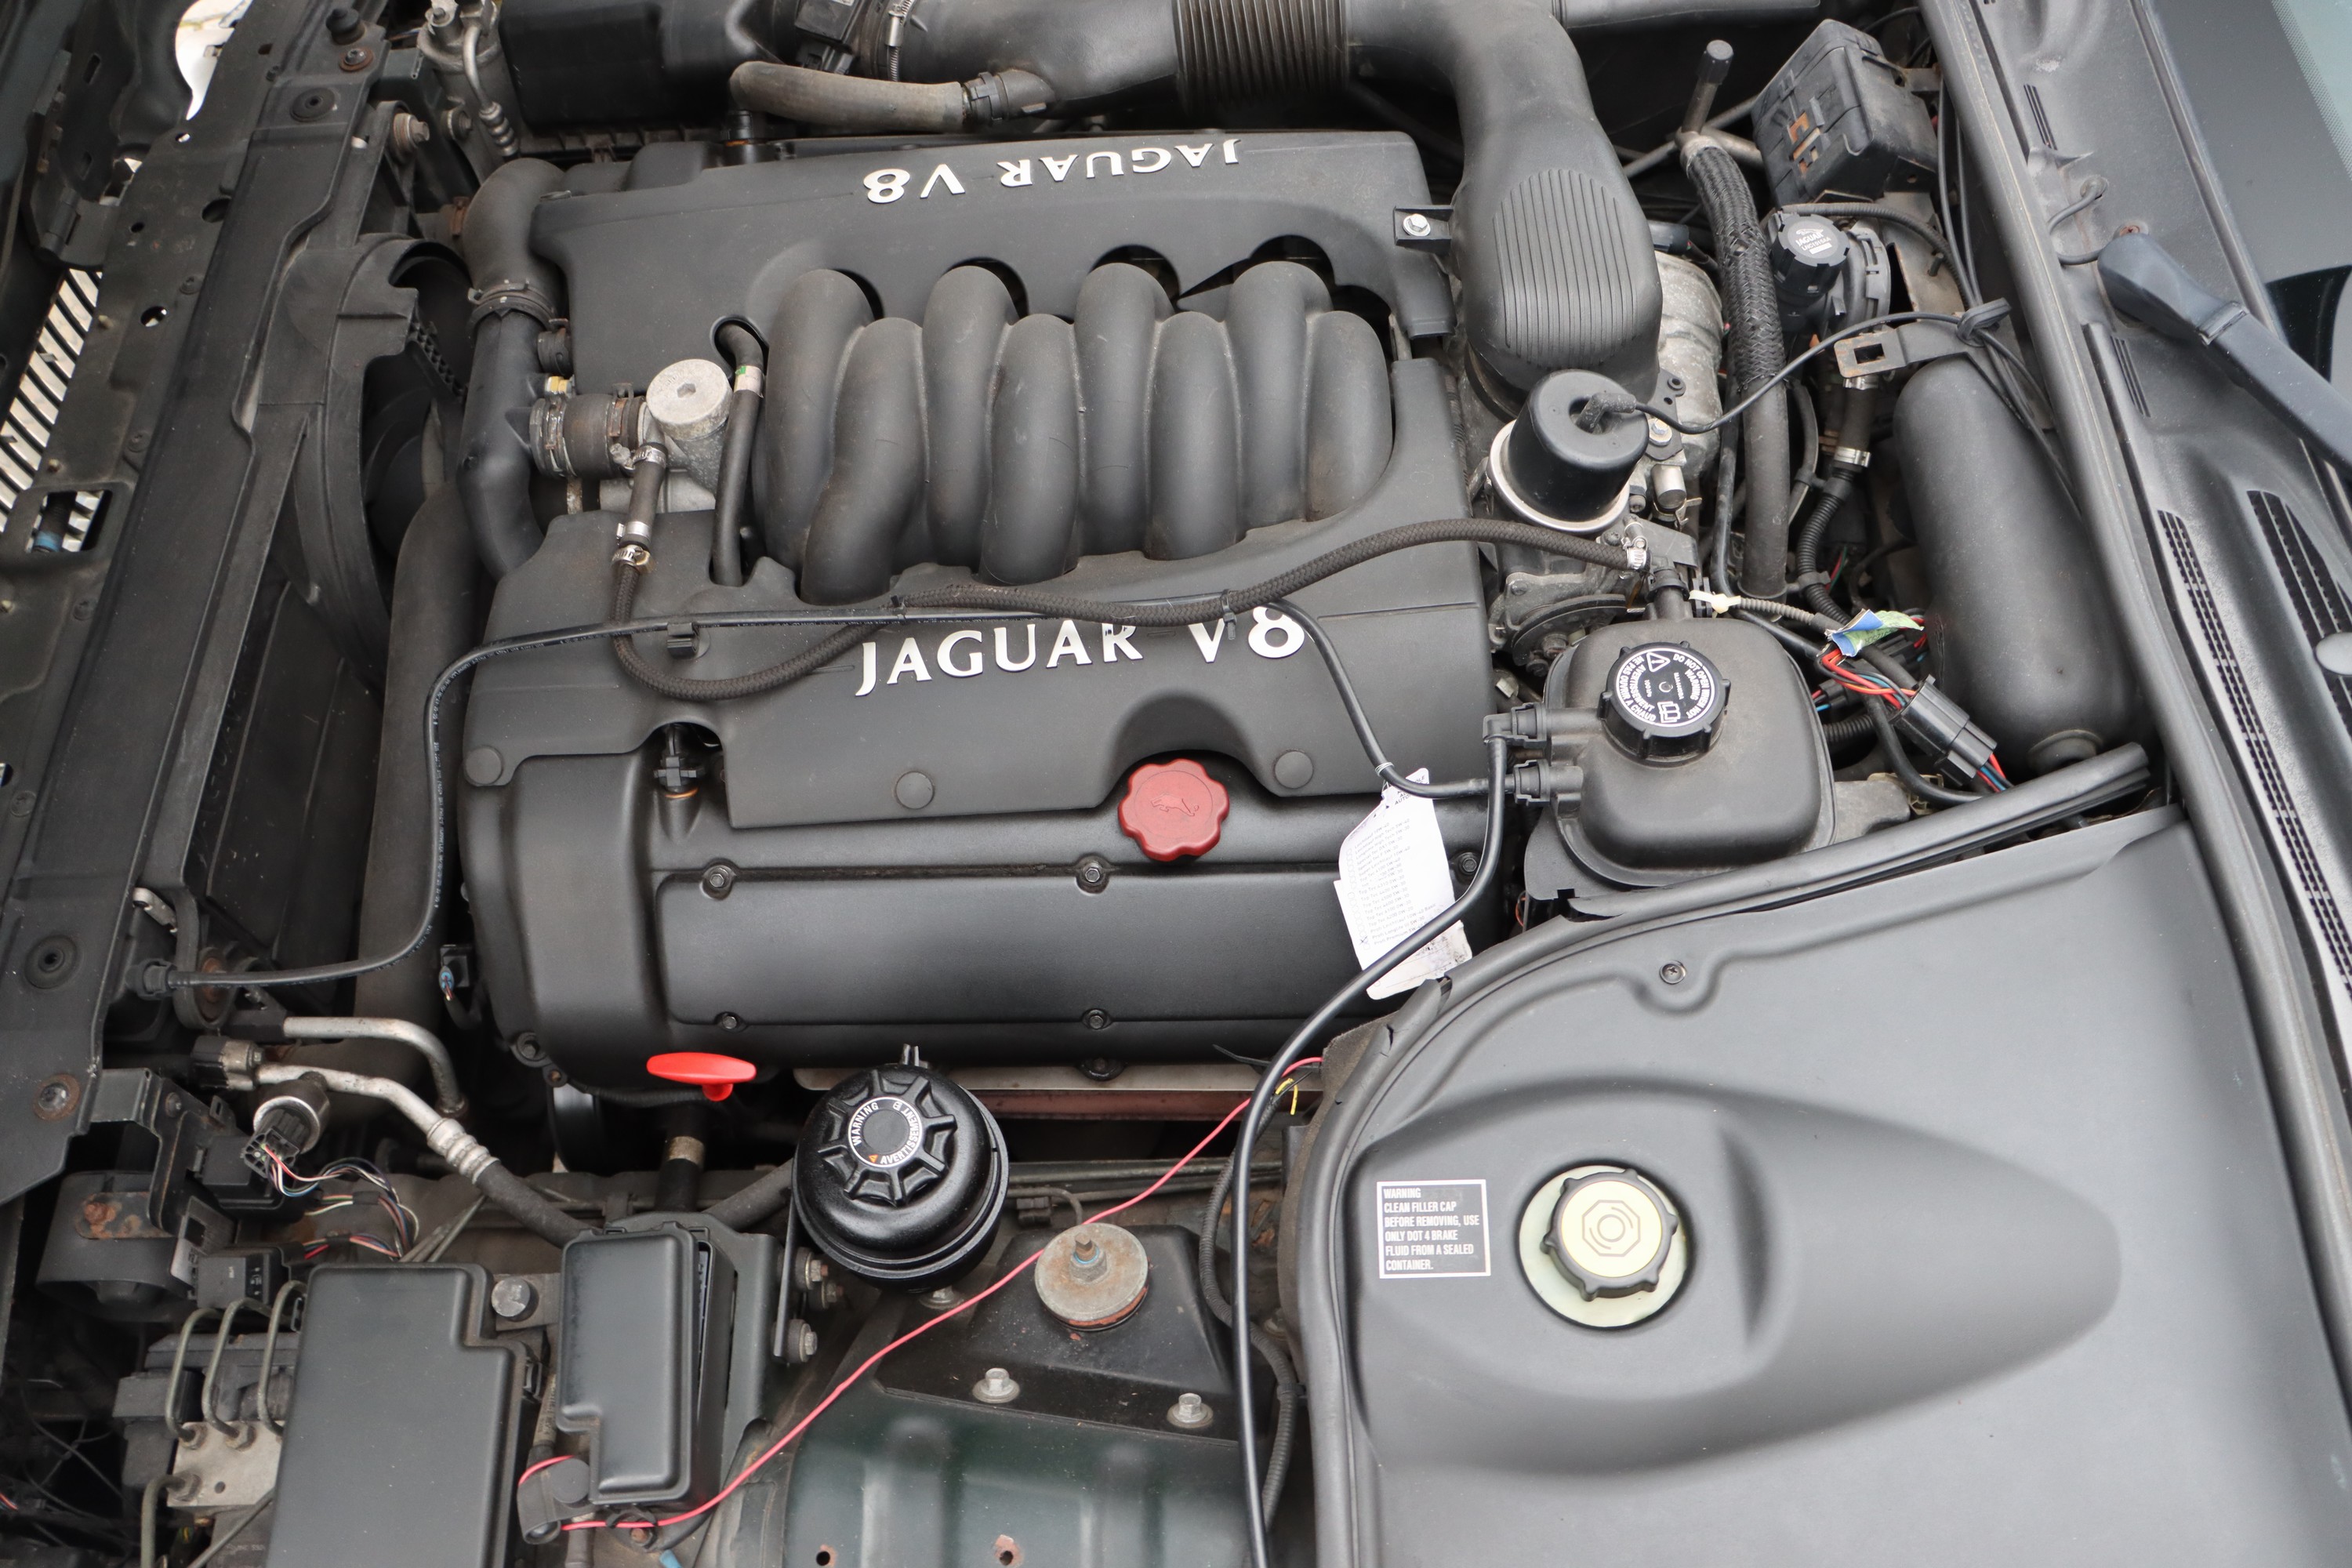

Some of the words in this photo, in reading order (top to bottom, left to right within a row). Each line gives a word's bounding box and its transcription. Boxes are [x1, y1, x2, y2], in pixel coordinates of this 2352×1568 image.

[996, 138, 1242, 188] JAGUAR
[862, 163, 967, 205] V8
[1795, 232, 1824, 247] JAGUAR
[855, 619, 1143, 698] JAGUAR
[1188, 606, 1305, 663] V8
[1633, 655, 1645, 664] NE
[1673, 653, 1685, 663] DO
[1622, 662, 1636, 675] PAS
[1685, 659, 1700, 671] NOT
[1685, 669, 1700, 701] WARNING
[1696, 669, 1710, 688] OPEN
[1619, 675, 1631, 700] OUVRIR
[1629, 664, 1655, 712] AVERTISSEMENT
[1699, 688, 1711, 708] WHEN
[1631, 703, 1657, 722] CHAUD
[1686, 706, 1702, 719] HOT
[851, 1102, 879, 1146] WARNING
[880, 1108, 919, 1164] AVERTISSEMENT
[1384, 1188, 1421, 1199] WARNING
[1384, 1202, 1410, 1213] CLEAN
[1411, 1201, 1439, 1213] FILLER
[1439, 1201, 1457, 1212] CAP
[1385, 1216, 1415, 1228] BEFORE
[1416, 1215, 1461, 1227] REMOVING,
[1463, 1214, 1480, 1225] USE
[1385, 1231, 1406, 1242] ONLY
[1406, 1230, 1424, 1242] DOT
[1424, 1229, 1431, 1241] 4
[1431, 1229, 1458, 1241] BRAKE
[1385, 1245, 1410, 1256] FLUID
[1410, 1244, 1435, 1256] FROM
[1436, 1244, 1443, 1255] A
[1443, 1243, 1475, 1255] SEALED
[1385, 1259, 1434, 1271] CONTAINER.
